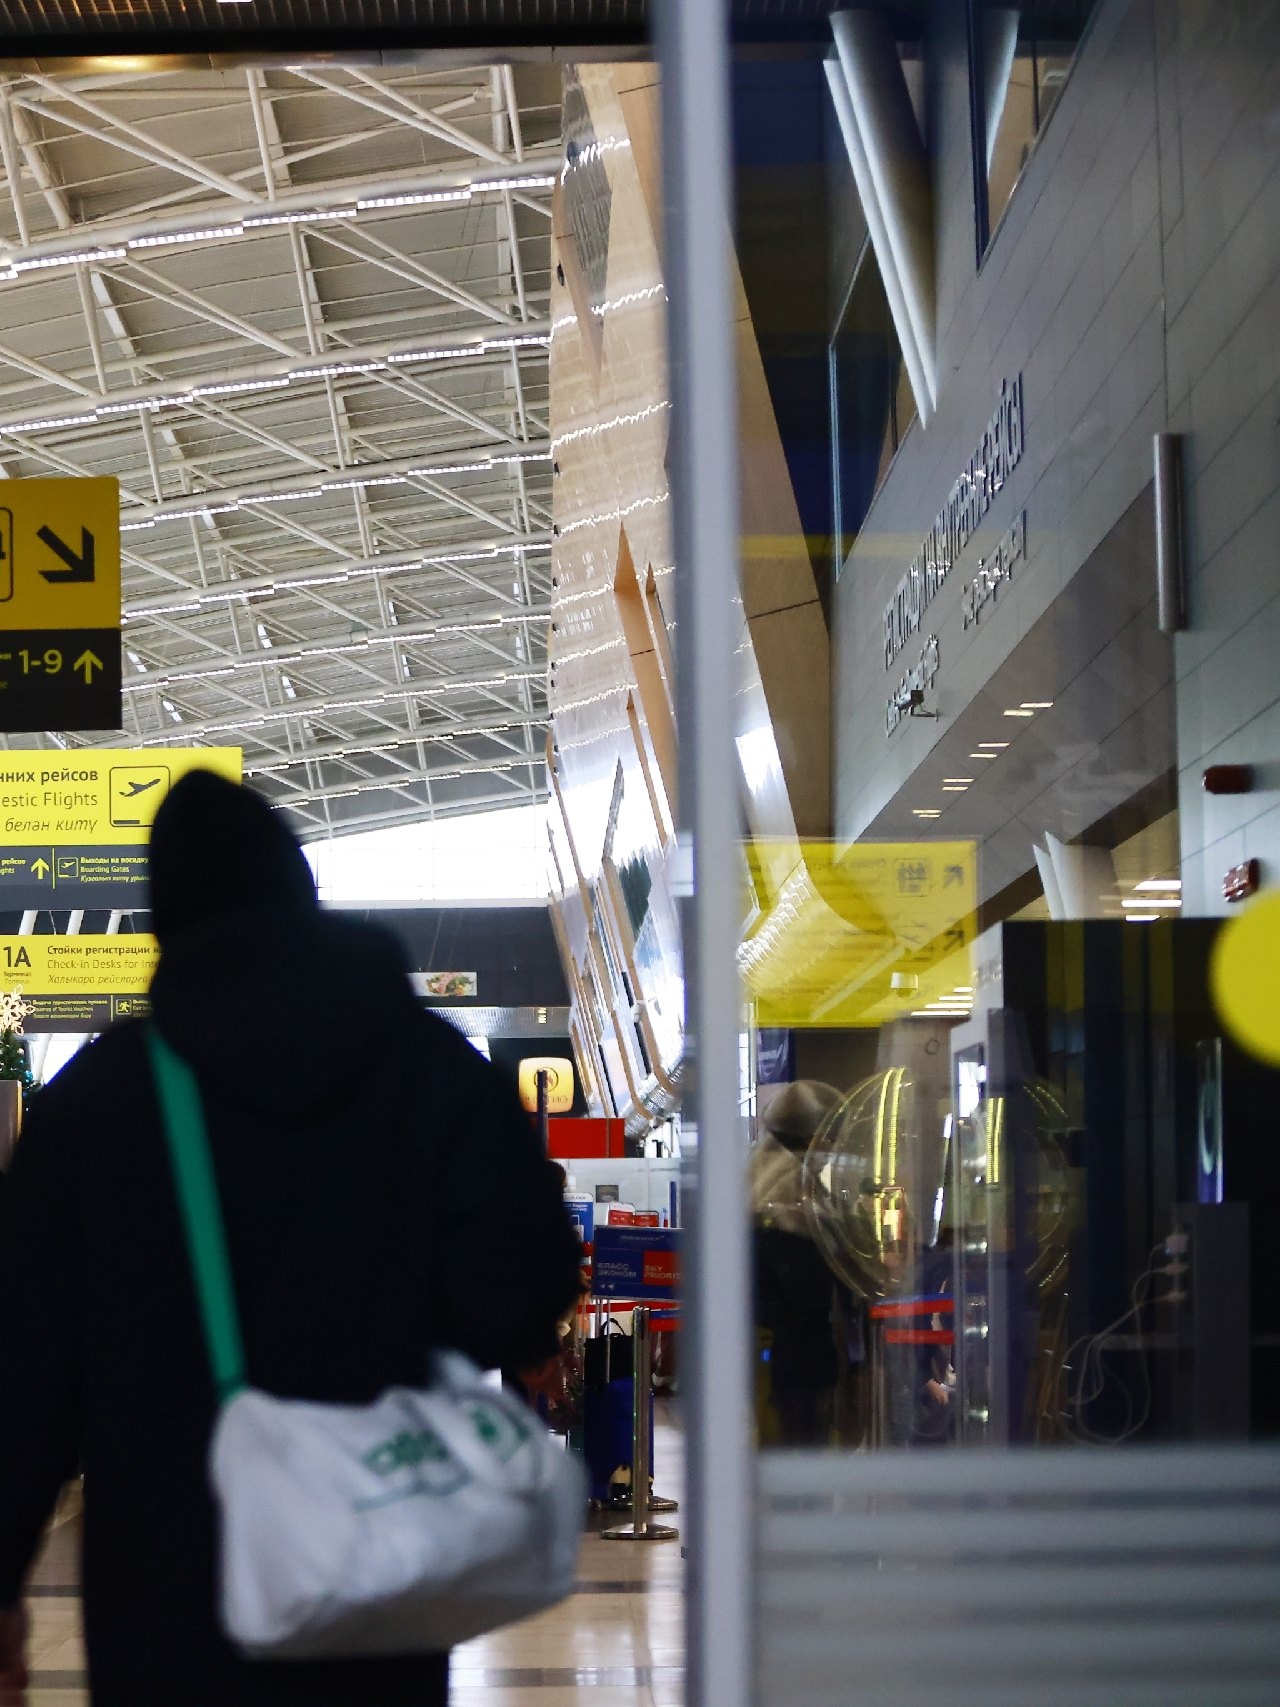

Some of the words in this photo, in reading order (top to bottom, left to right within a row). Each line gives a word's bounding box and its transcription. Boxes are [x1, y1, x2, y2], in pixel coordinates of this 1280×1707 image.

[18, 649, 64, 675] 1-9
[40, 767, 99, 786] рейсов
[43, 791, 98, 810] Flights
[3, 946, 32, 968] 1A
[47, 945, 82, 955] Стойки
[85, 946, 150, 956] регистрации
[47, 959, 90, 969] Check-in
[92, 959, 122, 969] Desks
[124, 959, 138, 969] for
[48, 974, 95, 984] Халыкара
